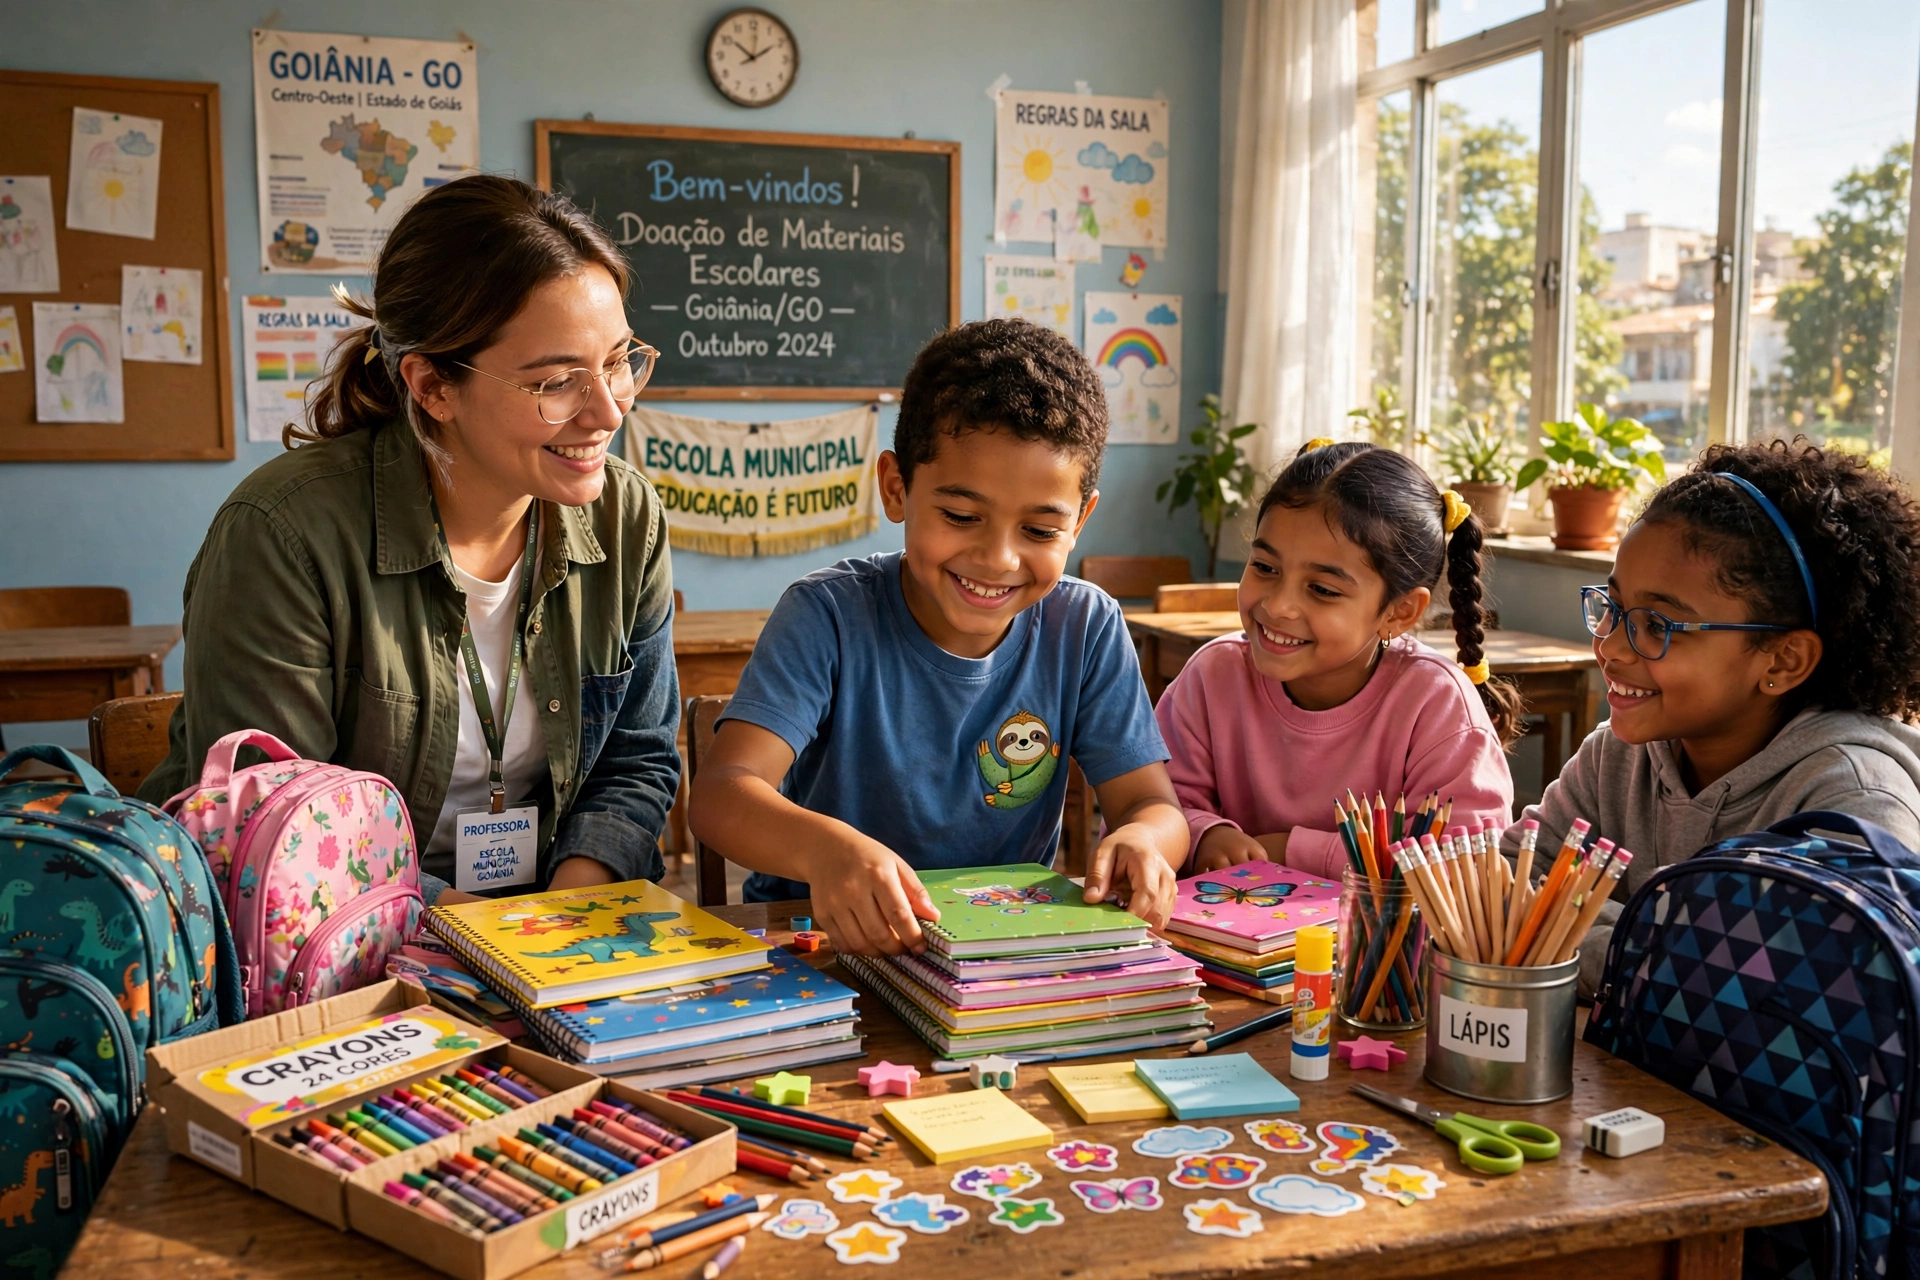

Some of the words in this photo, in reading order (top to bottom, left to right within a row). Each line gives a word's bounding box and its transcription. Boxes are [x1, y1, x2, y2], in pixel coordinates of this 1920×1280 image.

[270, 46, 395, 86] GOIÂNIA
[423, 59, 462, 89] GO
[271, 88, 354, 106] Centro-Oeste
[367, 92, 407, 108] Estado
[410, 94, 425, 109] de
[429, 97, 462, 111] Goiás
[1016, 103, 1079, 128] REGRAS
[1084, 107, 1105, 130] DA
[1110, 110, 1151, 133] SALA
[616, 211, 725, 252] Doação
[737, 214, 769, 248] de
[782, 218, 905, 253] Materiais
[689, 253, 820, 288] Escolares
[684, 292, 823, 327] Goiânia/GO
[678, 331, 768, 358] Outubro
[777, 331, 837, 359] 2024
[645, 437, 735, 478] ESCOLA
[744, 436, 864, 478] MUNICIPAL
[766, 487, 777, 517] É
[786, 481, 857, 516] FUTURO
[464, 819, 530, 837] PROFESSORA
[480, 846, 515, 858] ESCOLA
[1450, 1011, 1510, 1048] LÁPIS
[241, 1024, 422, 1086] CRAYONS
[302, 1072, 333, 1088] 24
[336, 1047, 411, 1076] CORES
[579, 1182, 650, 1231] CRAYONS
